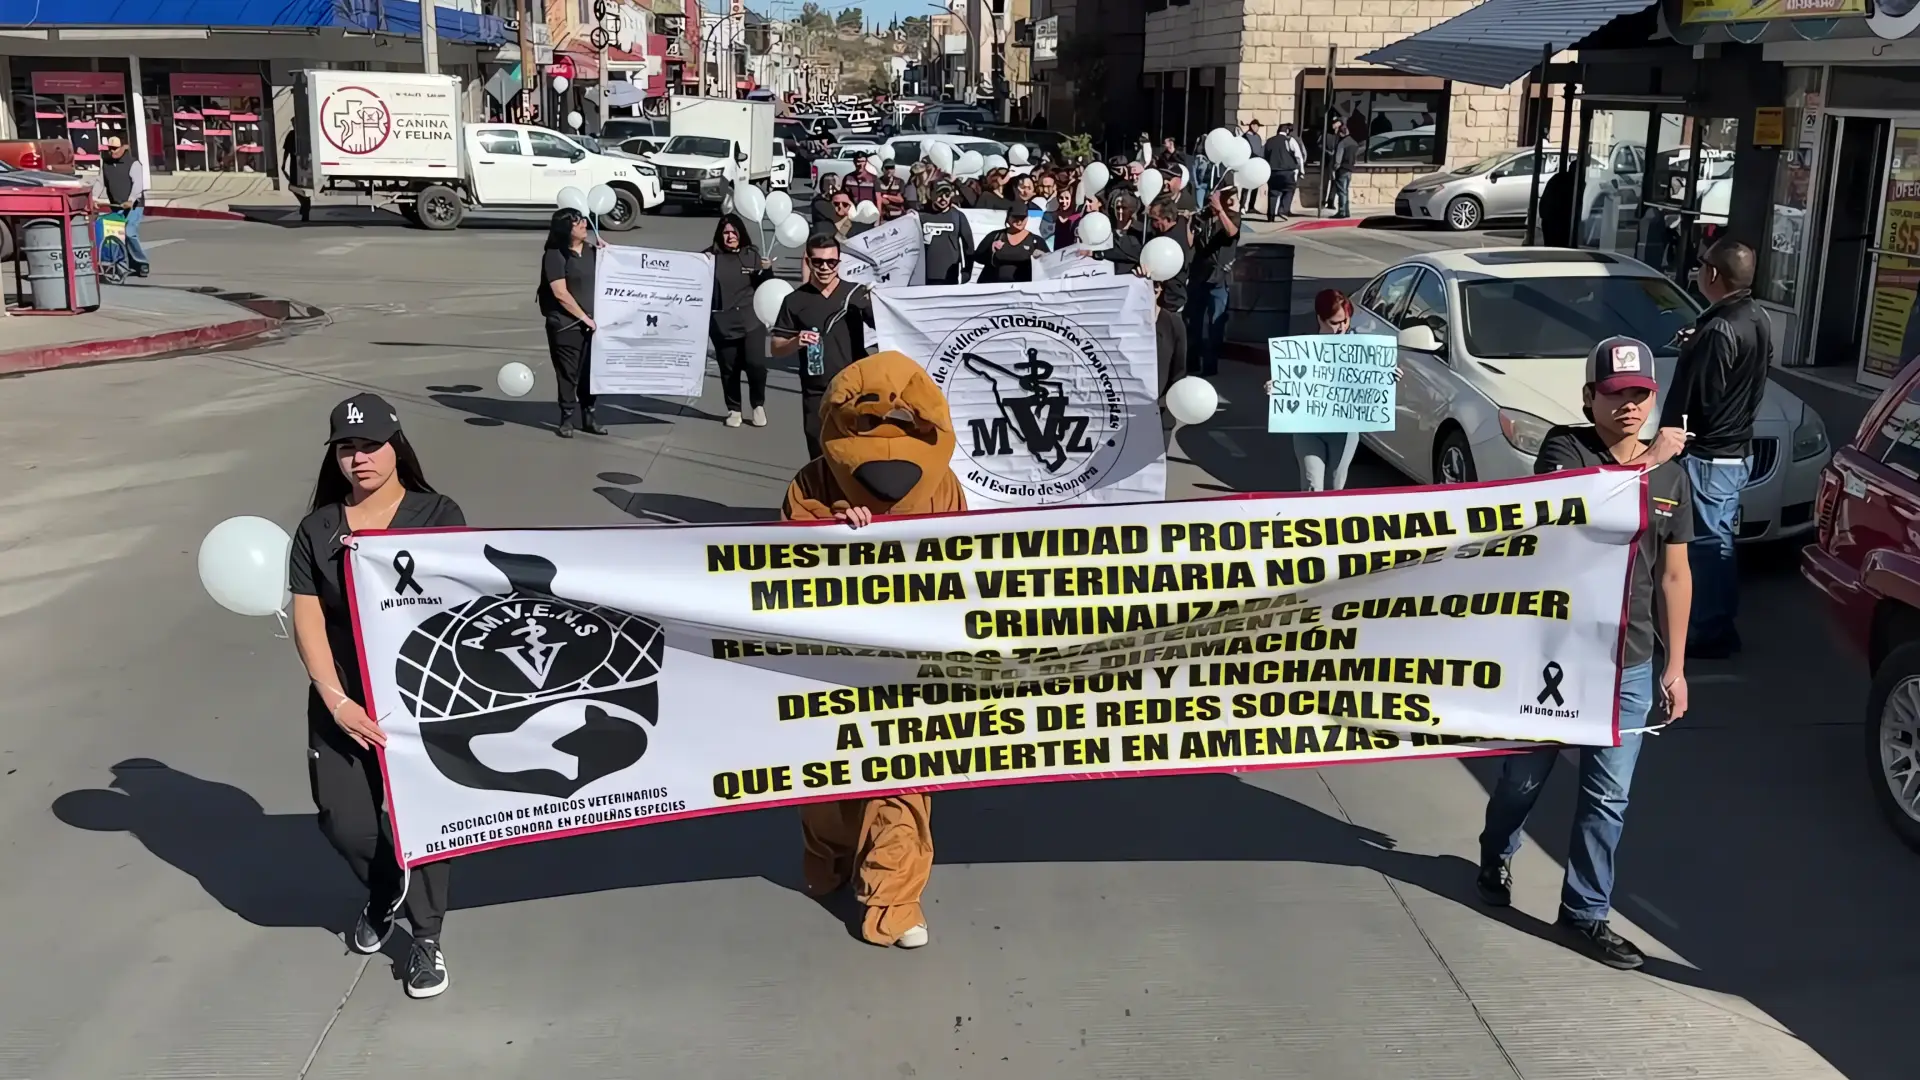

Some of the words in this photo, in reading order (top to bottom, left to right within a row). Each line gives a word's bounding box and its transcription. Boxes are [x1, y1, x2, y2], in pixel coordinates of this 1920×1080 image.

[393, 130, 401, 139] Y
[405, 130, 453, 141] FELINA
[396, 118, 448, 129] CANINA
[1271, 339, 1310, 360] SIN
[989, 315, 1082, 347] Veterinarios
[1080, 340, 1121, 430] Zootecnistas
[1312, 364, 1335, 383] HAY
[1271, 380, 1301, 398] SIN
[346, 402, 364, 424] LA
[1306, 399, 1328, 418] HAY
[1331, 403, 1391, 423] ANIMALES
[967, 470, 989, 488] del
[989, 479, 1036, 497] Estado
[1037, 483, 1053, 496] de
[706, 540, 906, 572] NUESTRA
[915, 525, 1148, 562] ACTIVIDAD
[1466, 503, 1524, 534] DE
[1535, 497, 1588, 526] LA
[751, 571, 966, 611] MEDICINA
[975, 561, 1256, 598] VETERINARIA
[1265, 556, 1326, 586] NO
[1454, 534, 1539, 560] SER
[395, 597, 416, 607] uno
[1331, 590, 1571, 621] CUALQUIER
[1099, 624, 1358, 669] DIFAMACIÓN
[1153, 665, 1180, 689] Y
[1188, 658, 1502, 689] LINCHAMIENTO
[836, 723, 864, 750] A
[871, 704, 1026, 747] TRAVÉS
[1036, 703, 1086, 733] DE
[1096, 695, 1222, 728] REDES
[1232, 690, 1441, 726] SOCIALES,
[1535, 706, 1554, 717] uno
[712, 766, 793, 800] QUE
[802, 760, 852, 788] SE
[861, 737, 1110, 783] CONVIERTEN
[1121, 733, 1169, 762] EN
[1179, 725, 1401, 760] AMENAZAS
[440, 810, 514, 835] ASOCIACIÓN
[516, 807, 531, 820] DE
[533, 798, 586, 817] MÉDICOS
[587, 787, 668, 807] VETERINARIOS
[425, 840, 447, 853] DEL
[448, 831, 487, 849] NORTE
[489, 828, 504, 840] DE
[505, 820, 554, 837] SONORA
[557, 816, 573, 828] EN
[574, 806, 632, 827] PEQUEÑAS
[634, 800, 686, 817] ESPECIES
